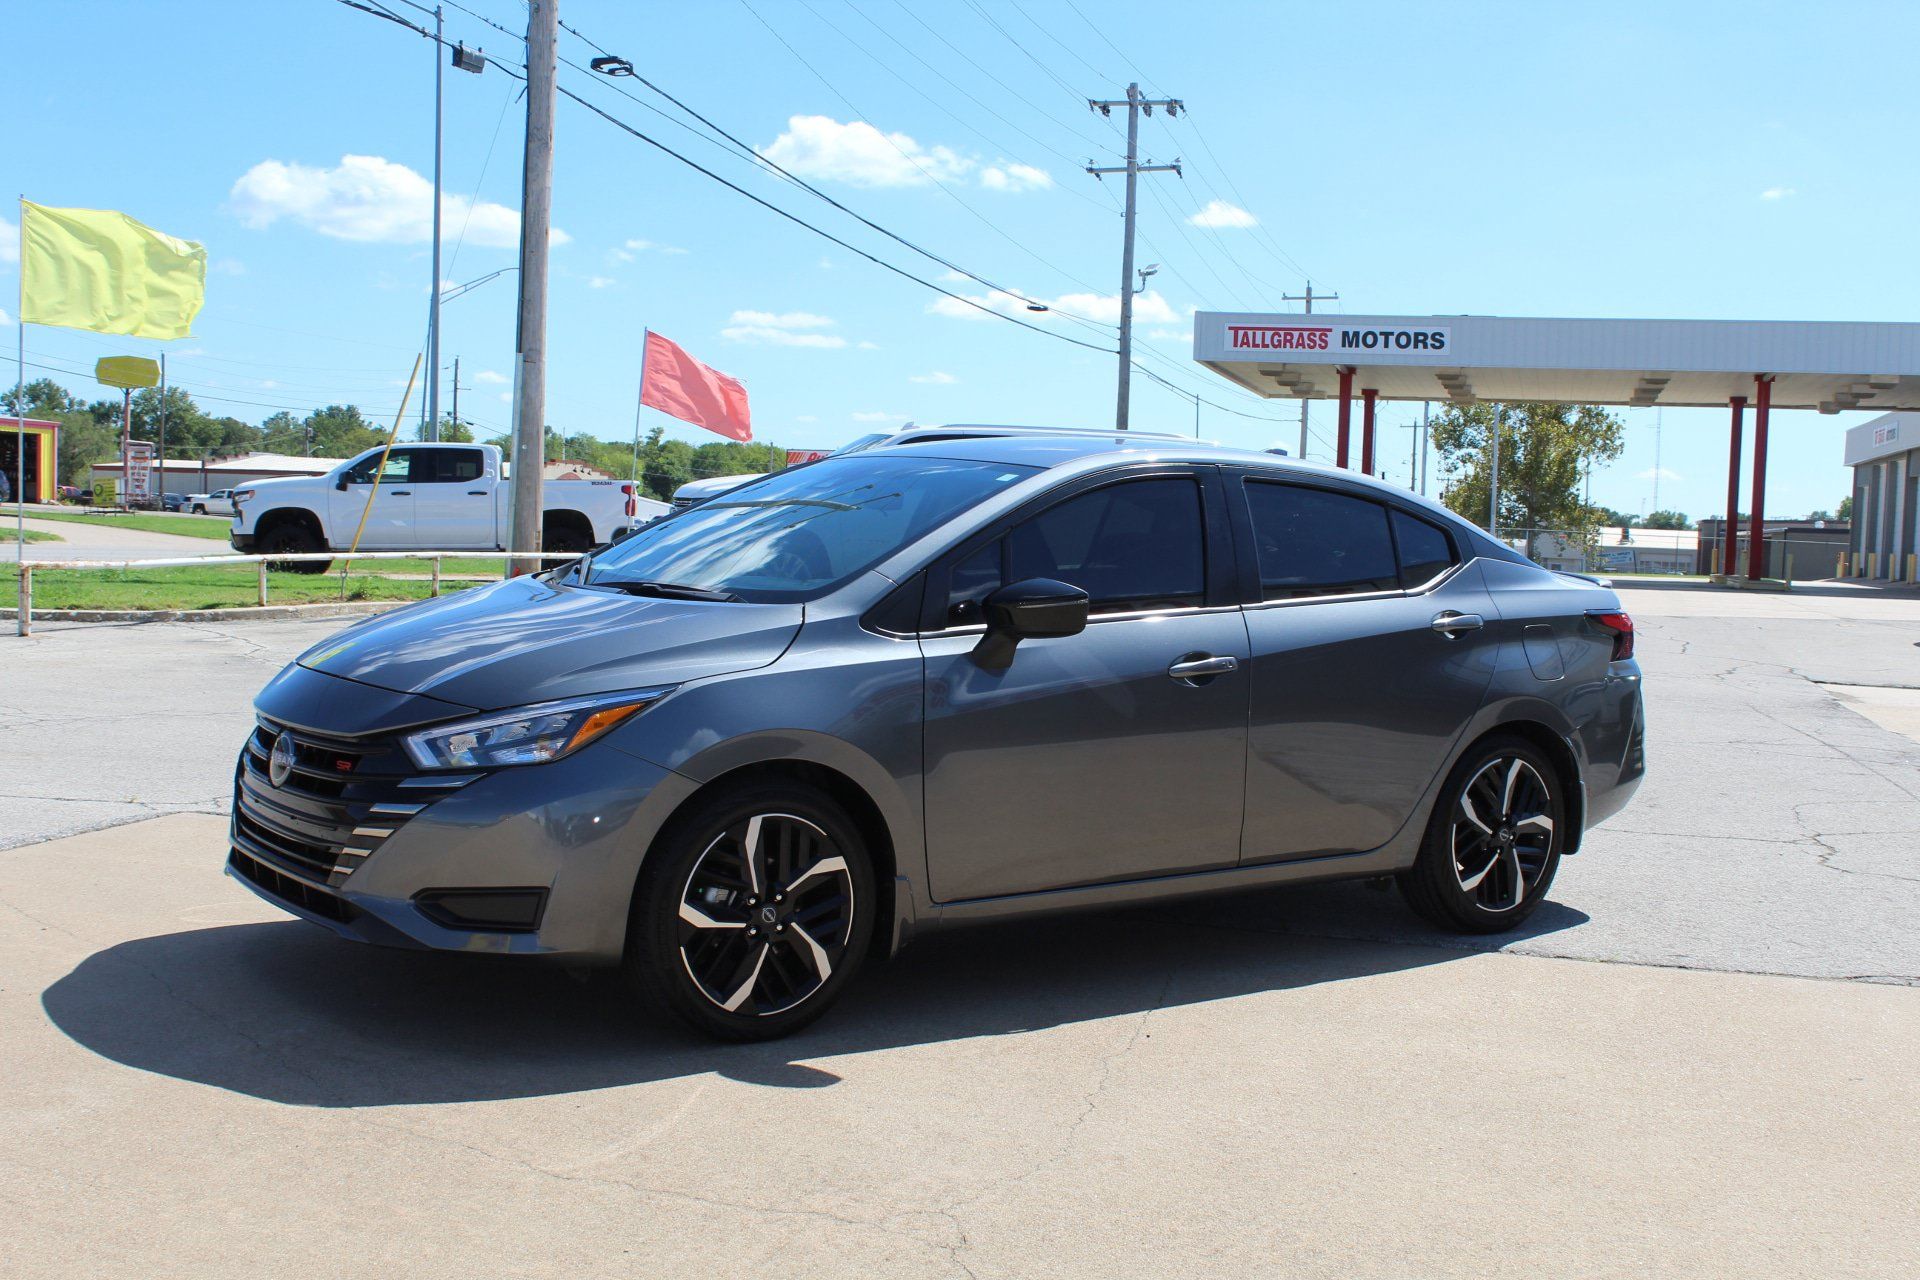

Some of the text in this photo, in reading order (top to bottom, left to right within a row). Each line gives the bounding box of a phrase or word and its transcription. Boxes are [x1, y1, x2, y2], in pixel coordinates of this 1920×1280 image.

[1228, 326, 1445, 350] TALLGRASS MOTORS
[336, 760, 352, 771] SR
